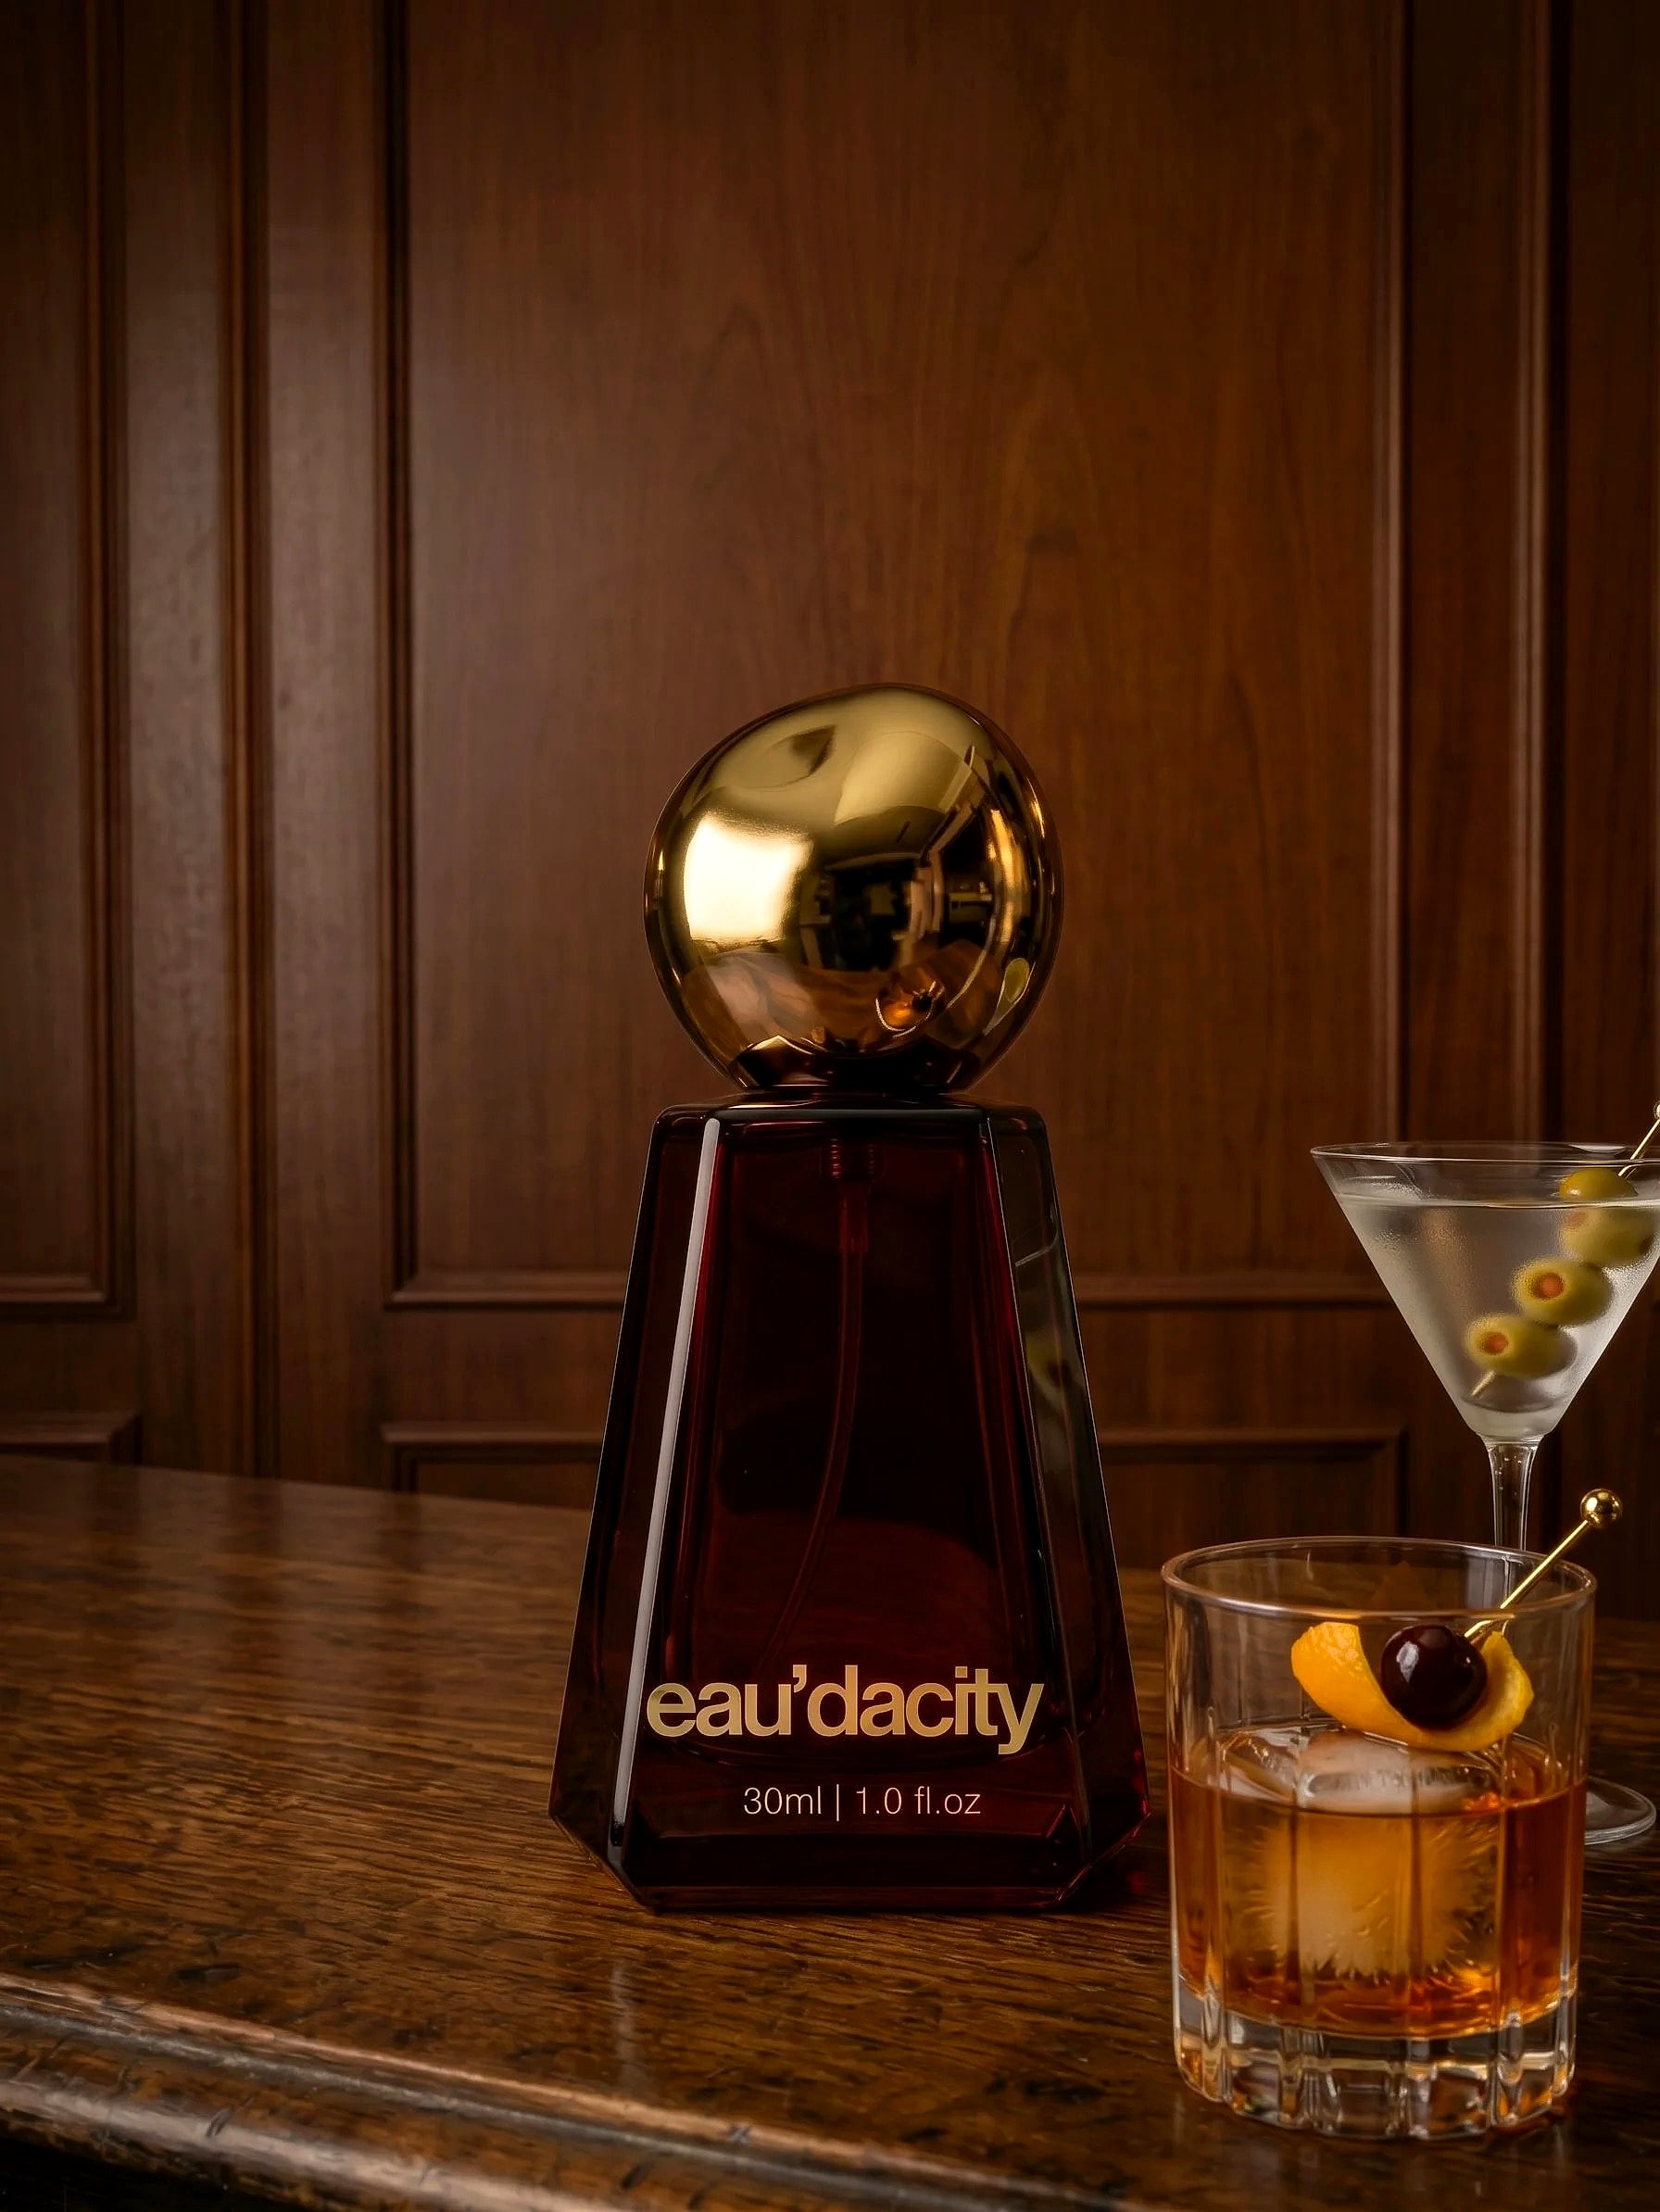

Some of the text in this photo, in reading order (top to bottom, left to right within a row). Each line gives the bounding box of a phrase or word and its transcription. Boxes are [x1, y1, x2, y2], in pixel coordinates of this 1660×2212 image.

[646, 1664, 1045, 1755] eau'dacity
[743, 1786, 823, 1816] 30ml
[856, 1787, 902, 1816] 1.0
[913, 1786, 982, 1816] fl.oz
